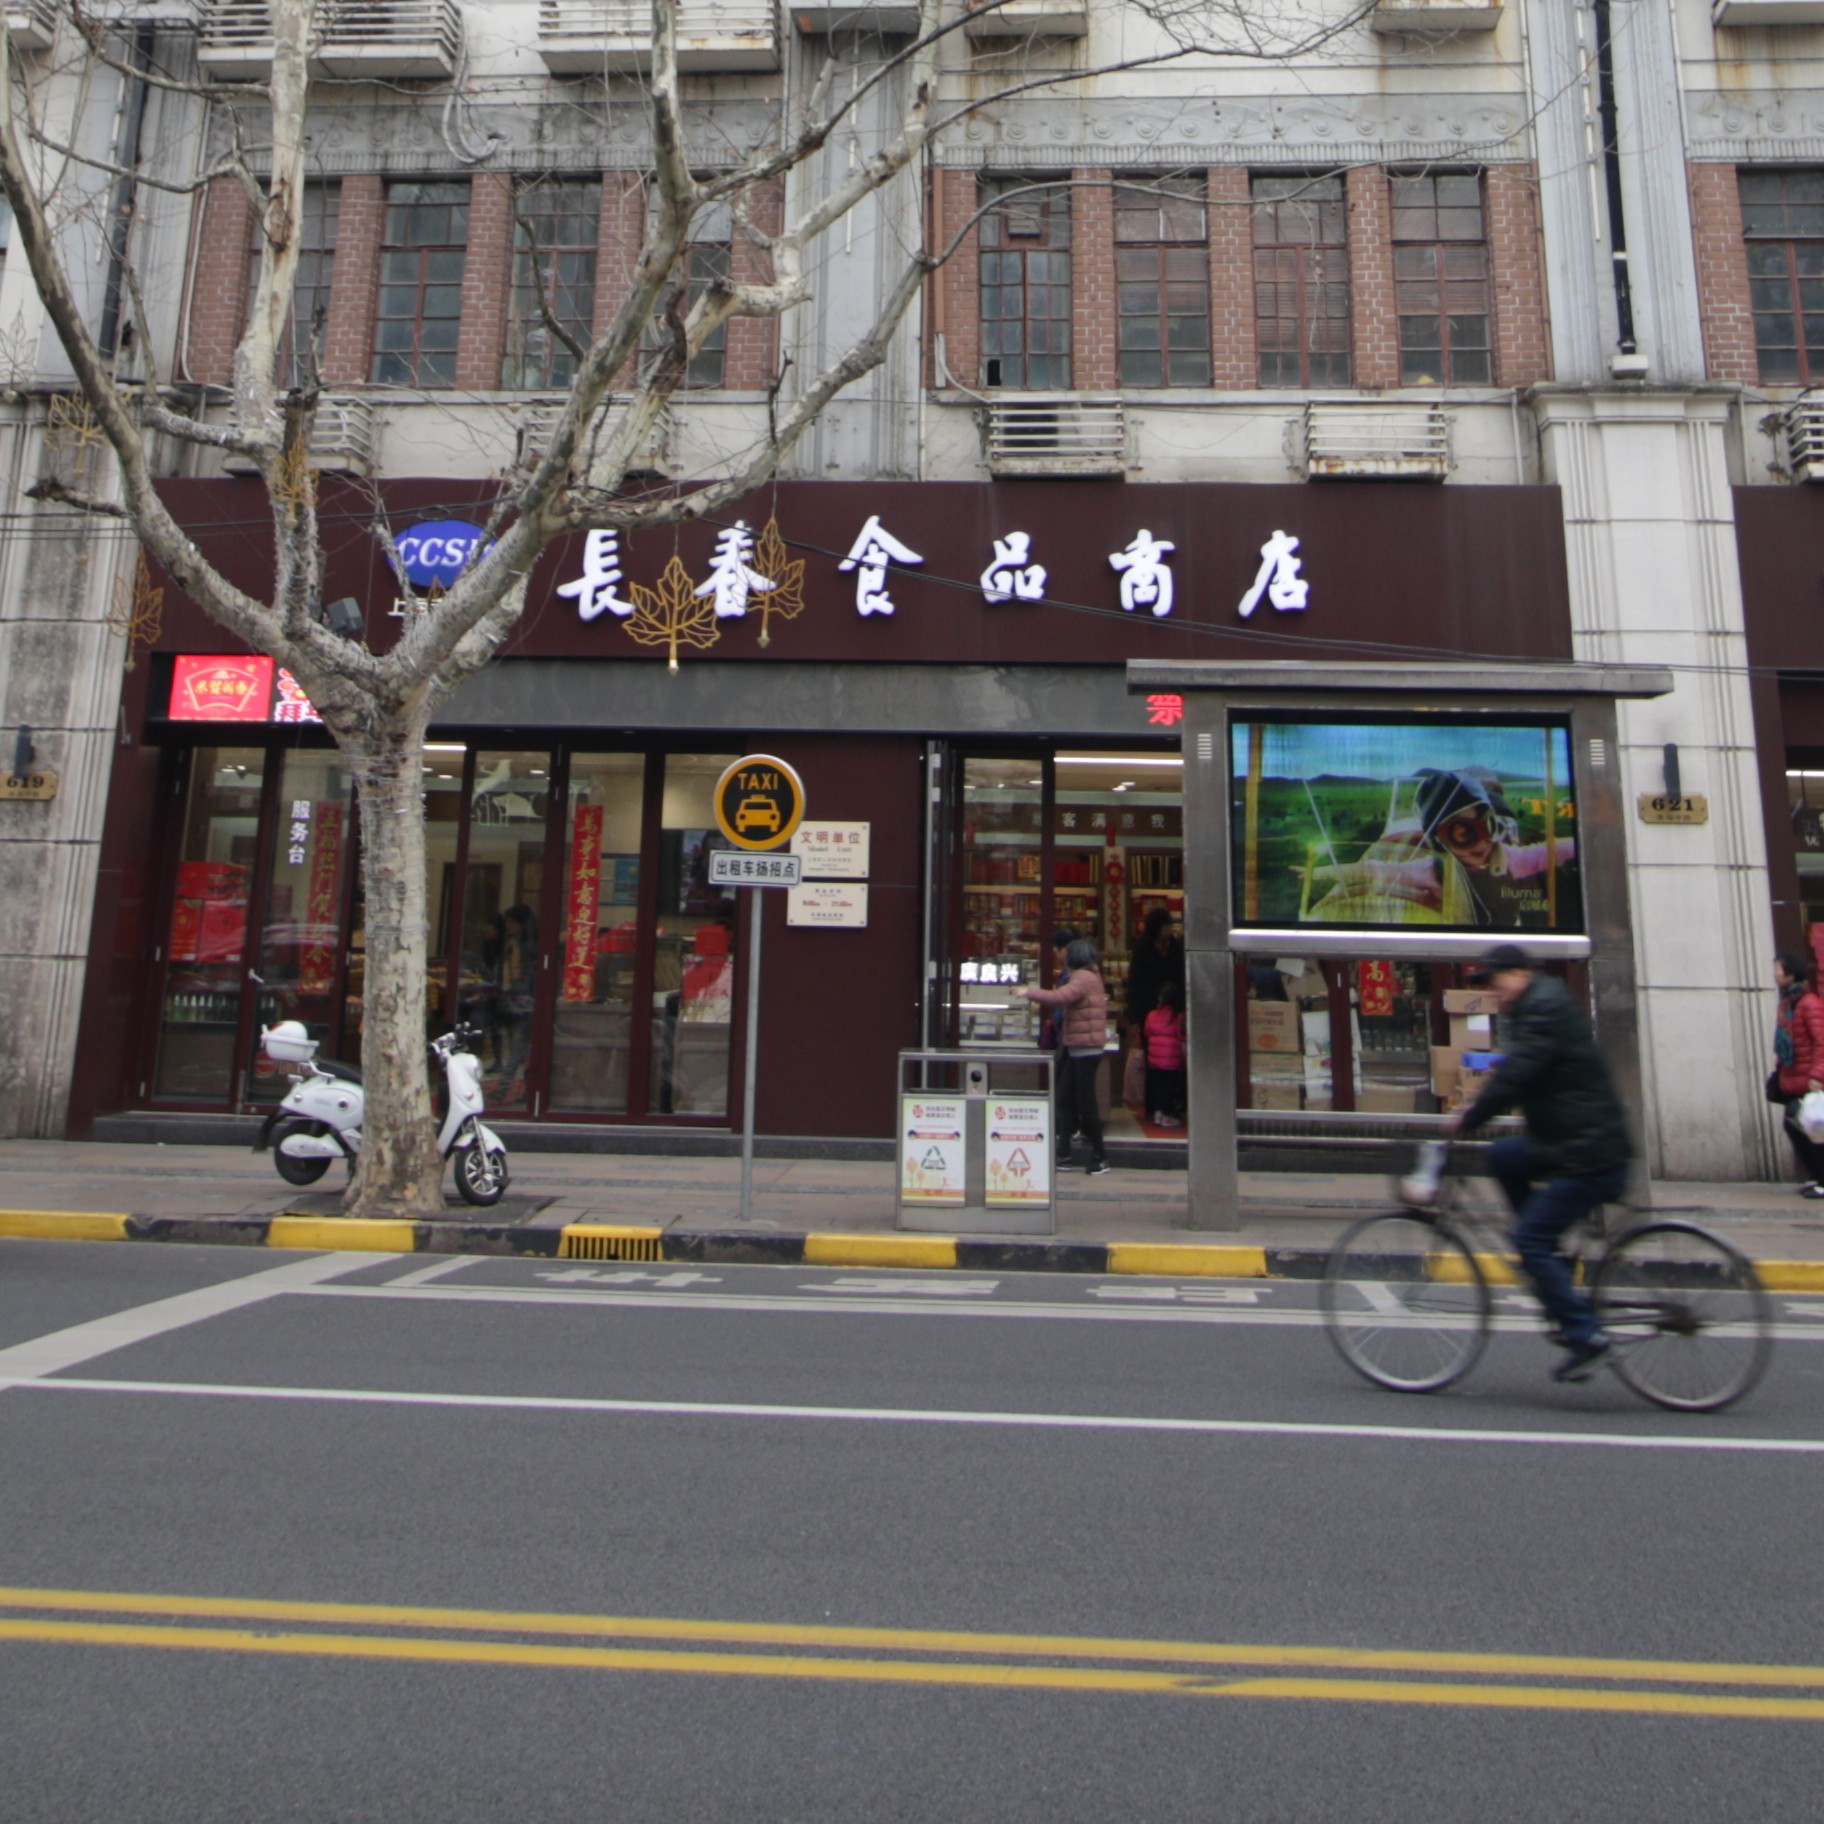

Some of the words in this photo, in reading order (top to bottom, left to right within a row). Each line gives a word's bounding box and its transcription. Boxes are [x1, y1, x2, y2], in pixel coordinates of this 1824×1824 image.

[7, 775, 45, 788] 619
[737, 772, 779, 790] TAXI
[1651, 797, 1694, 811] 621
[288, 799, 312, 865] 服务台
[800, 830, 861, 845] 文明单位
[716, 859, 795, 878] 出租车扬招点
